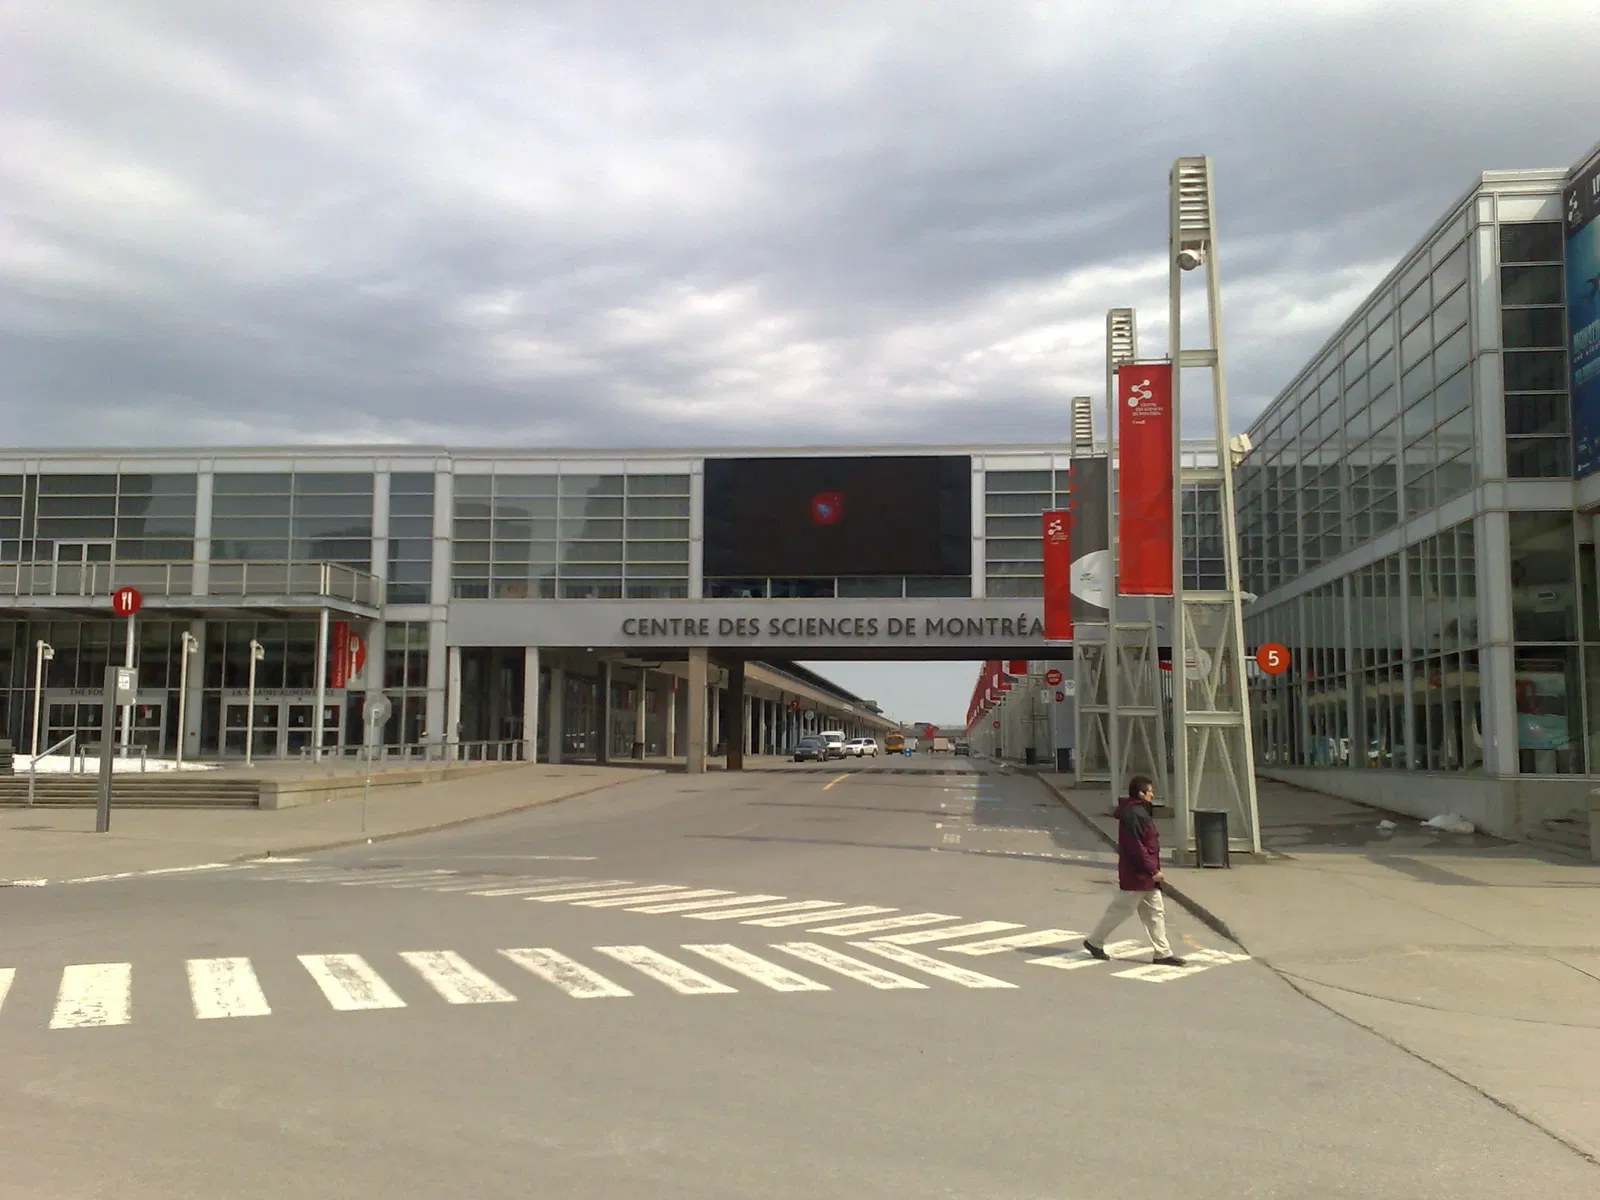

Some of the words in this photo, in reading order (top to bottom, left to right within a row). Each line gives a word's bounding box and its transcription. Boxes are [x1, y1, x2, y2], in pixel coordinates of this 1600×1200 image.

[622, 618, 709, 636] CENTRE
[718, 618, 759, 636] DES
[769, 618, 878, 636] SCIENCES
[888, 618, 916, 636] DE
[926, 613, 1044, 636] MONTRÉA
[1268, 650, 1279, 666] 5
